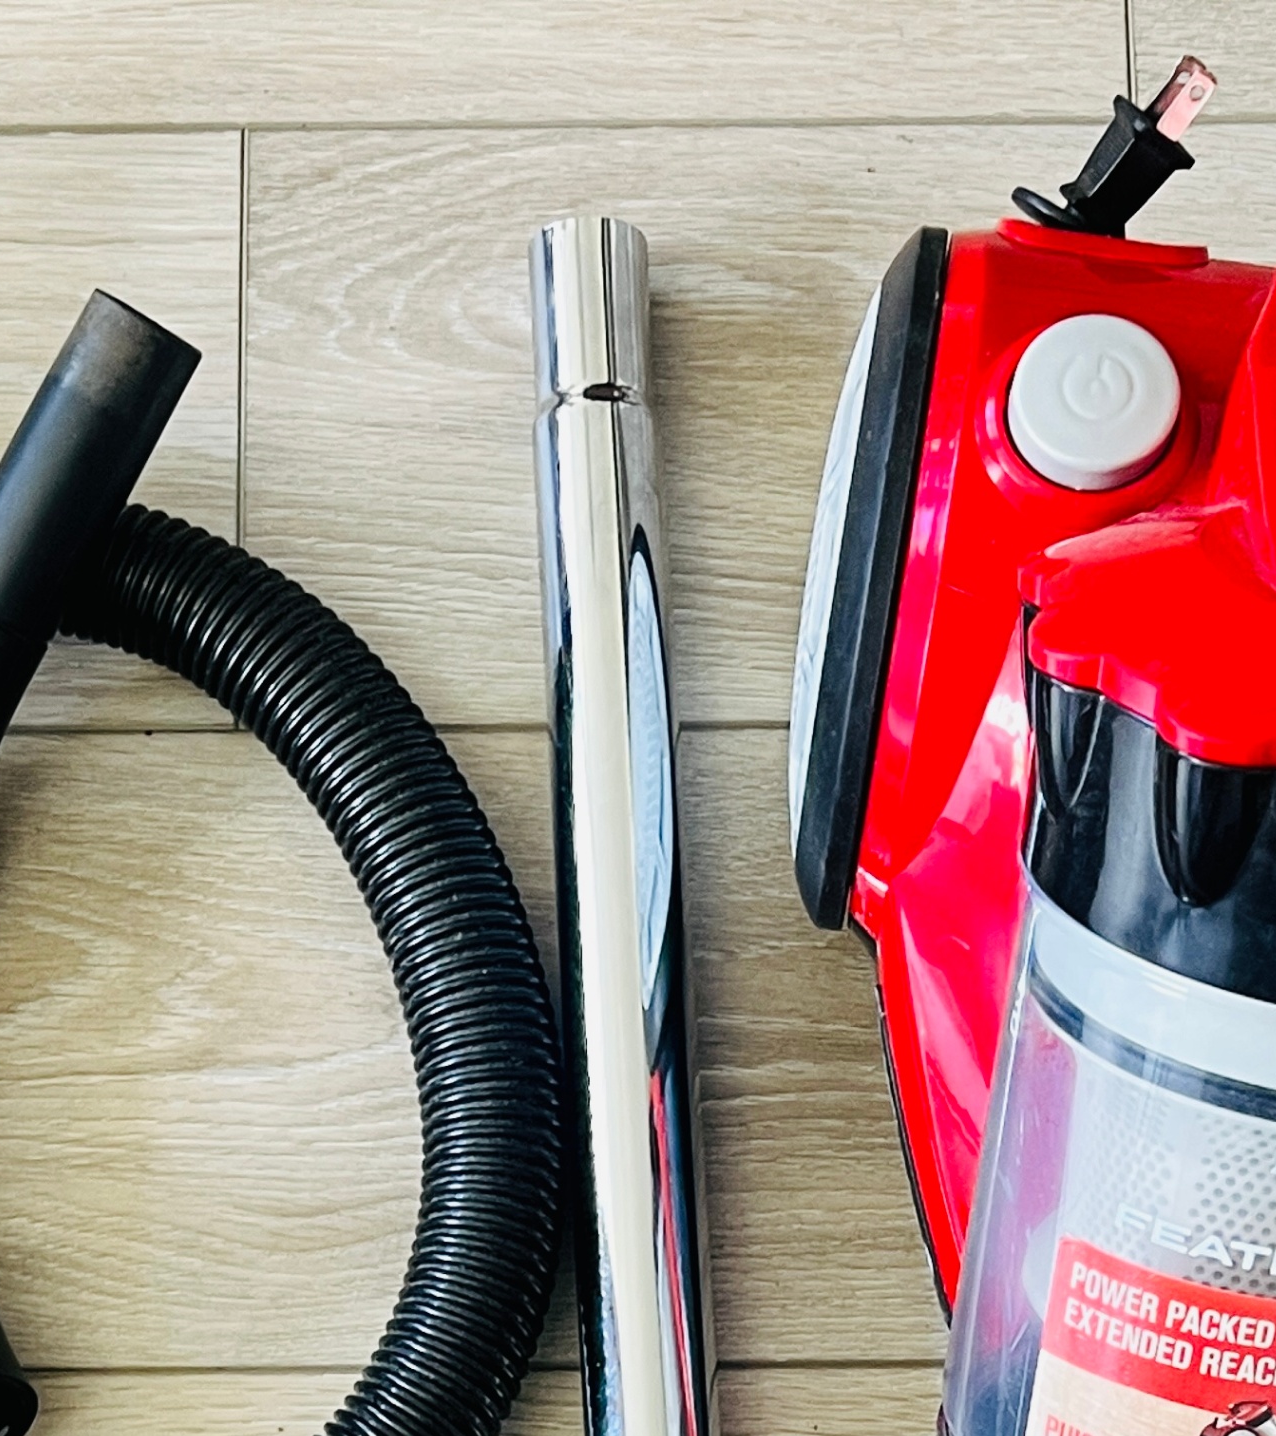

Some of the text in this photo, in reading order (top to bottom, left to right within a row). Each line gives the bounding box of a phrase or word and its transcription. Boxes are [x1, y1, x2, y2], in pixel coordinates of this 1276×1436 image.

[1064, 1297, 1194, 1370] EXTENDED
[1070, 1262, 1159, 1323] POWER
[1165, 1301, 1275, 1350] PACKED
